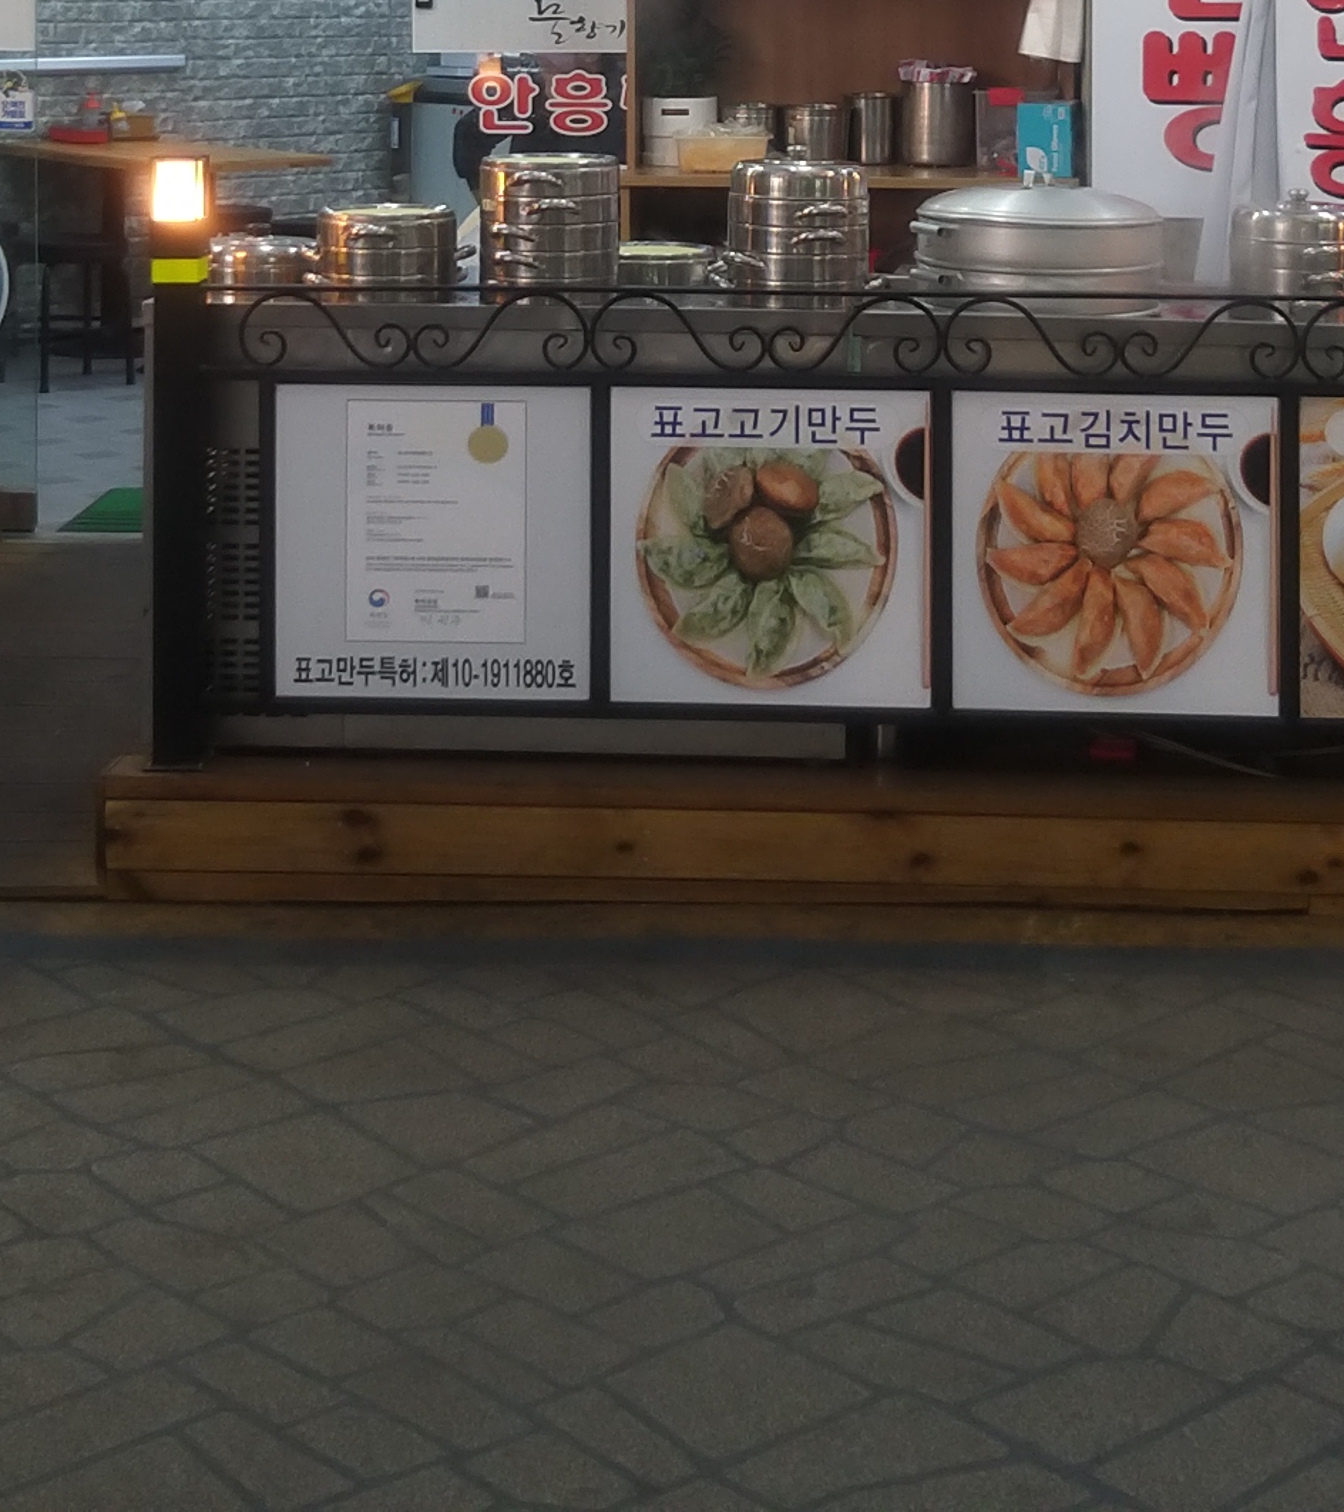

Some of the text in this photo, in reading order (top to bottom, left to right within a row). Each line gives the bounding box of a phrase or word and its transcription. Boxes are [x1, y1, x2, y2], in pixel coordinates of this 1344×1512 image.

[469, 69, 627, 136] 안흥
[649, 403, 881, 445] 표고고기만두
[998, 408, 1233, 451] 표고김치만두
